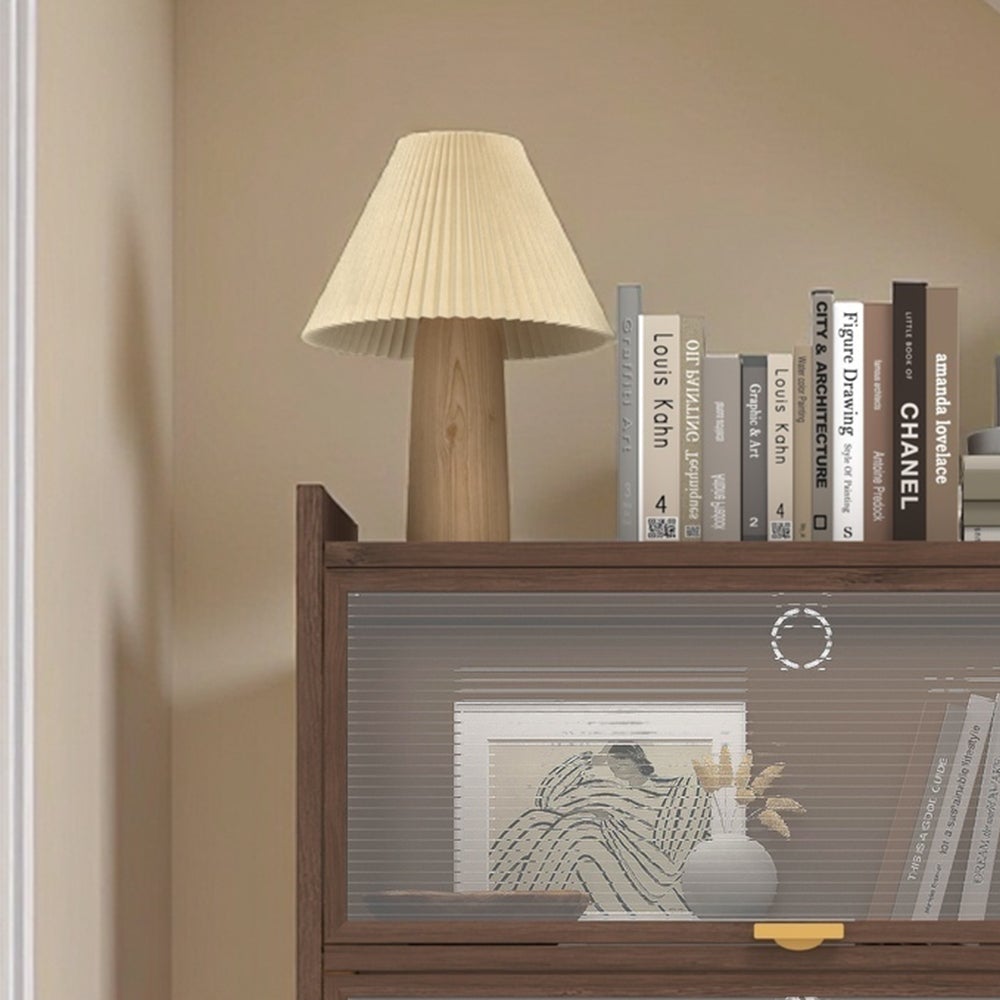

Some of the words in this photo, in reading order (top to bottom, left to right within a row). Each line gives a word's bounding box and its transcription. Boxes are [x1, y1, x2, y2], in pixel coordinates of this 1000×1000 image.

[816, 300, 828, 340] CITY
[838, 312, 858, 364] Figure
[905, 311, 913, 339] LITTLE
[653, 333, 673, 386] Louis
[797, 356, 807, 377] Water
[815, 342, 827, 356] &
[905, 340, 913, 366] BOOK
[746, 383, 762, 425] Graphic
[774, 368, 789, 413] Louis
[838, 368, 858, 437] Drawing
[935, 353, 951, 415] amanda
[653, 399, 673, 449] Kahn
[750, 427, 762, 438] &
[774, 423, 789, 465] Kahn
[815, 361, 828, 489] ARCHITECTURE
[750, 439, 762, 459] Art
[901, 402, 919, 510] CHANEL
[935, 420, 951, 485] lovelace
[655, 495, 667, 513] 4
[750, 517, 758, 527] 2
[776, 503, 784, 518] 4
